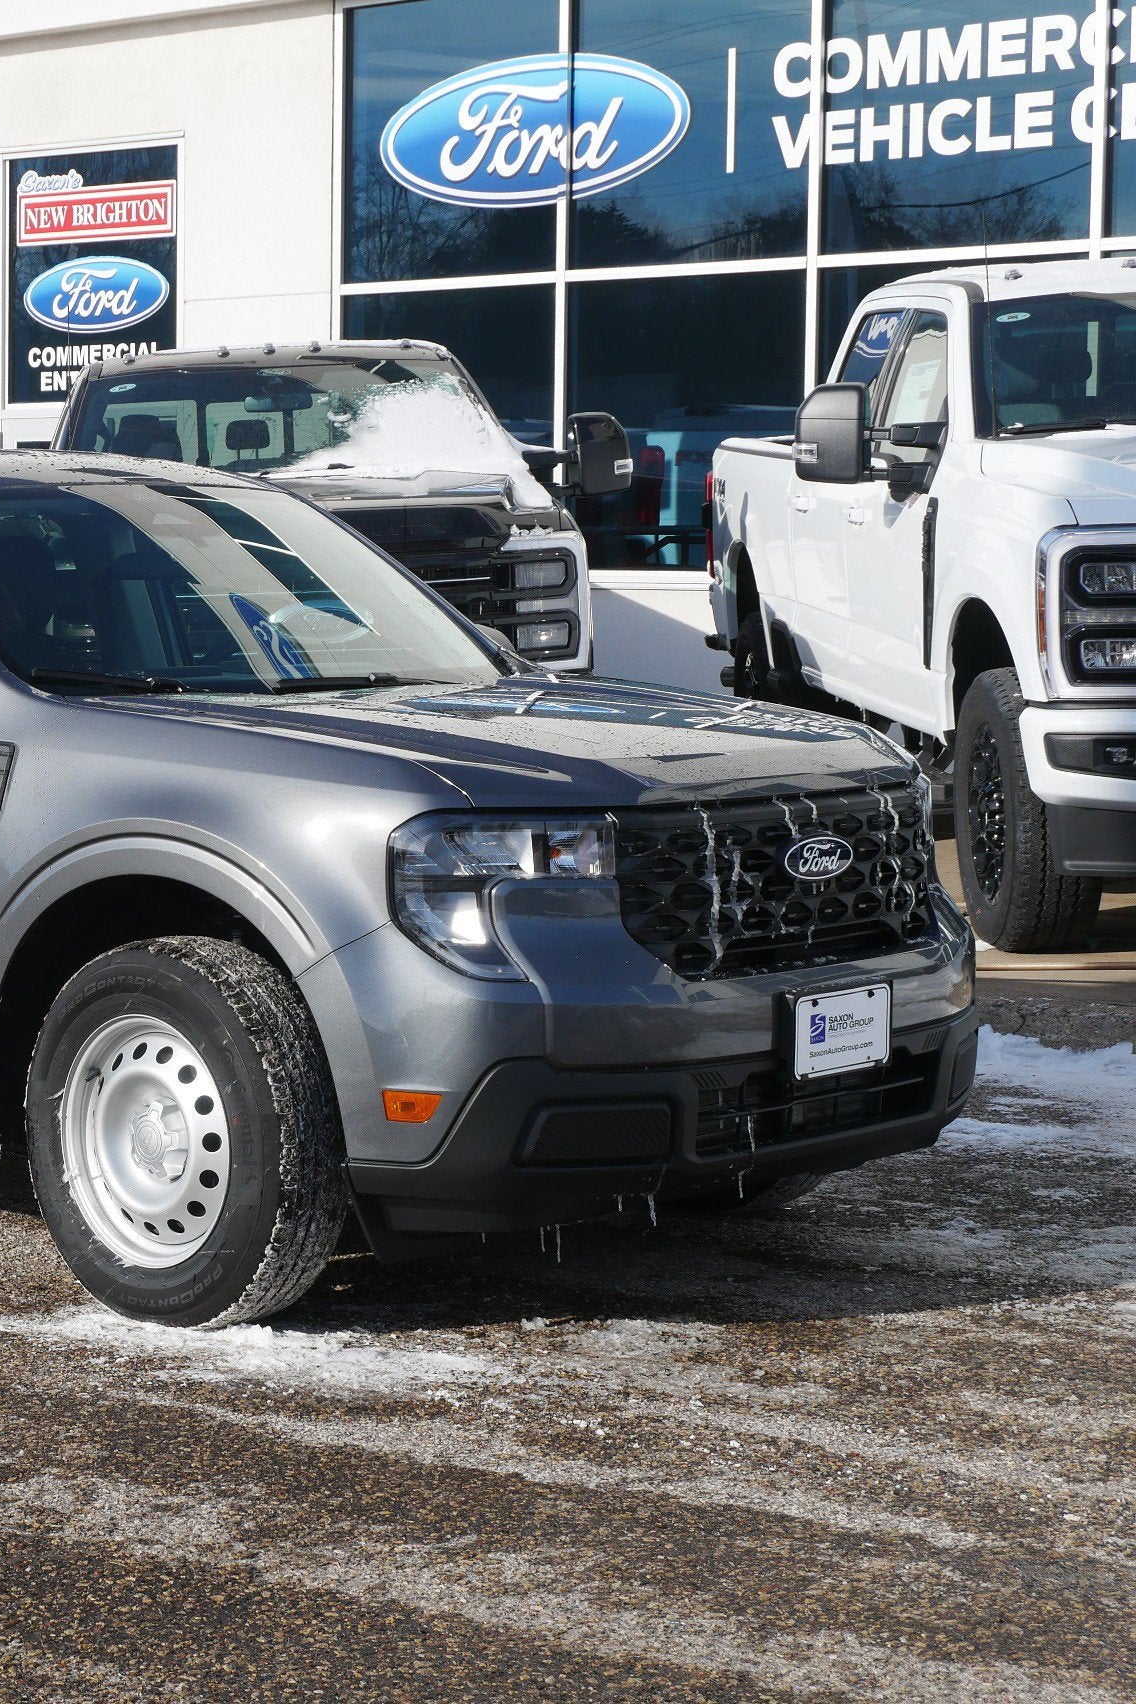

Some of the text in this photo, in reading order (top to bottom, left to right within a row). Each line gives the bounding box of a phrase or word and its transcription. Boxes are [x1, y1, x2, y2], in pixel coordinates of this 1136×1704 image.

[439, 79, 624, 182] Ford
[771, 90, 1055, 169] VEHICLE
[19, 170, 82, 193] Saxon's
[25, 198, 166, 229] NEW BRIGHTON
[52, 266, 140, 319] Ford
[798, 843, 841, 873] Ford
[828, 1012, 854, 1025] SAXON
[828, 1016, 874, 1032] AUTO GROUP
[809, 1041, 874, 1058] SaxonAutoGroup.com
